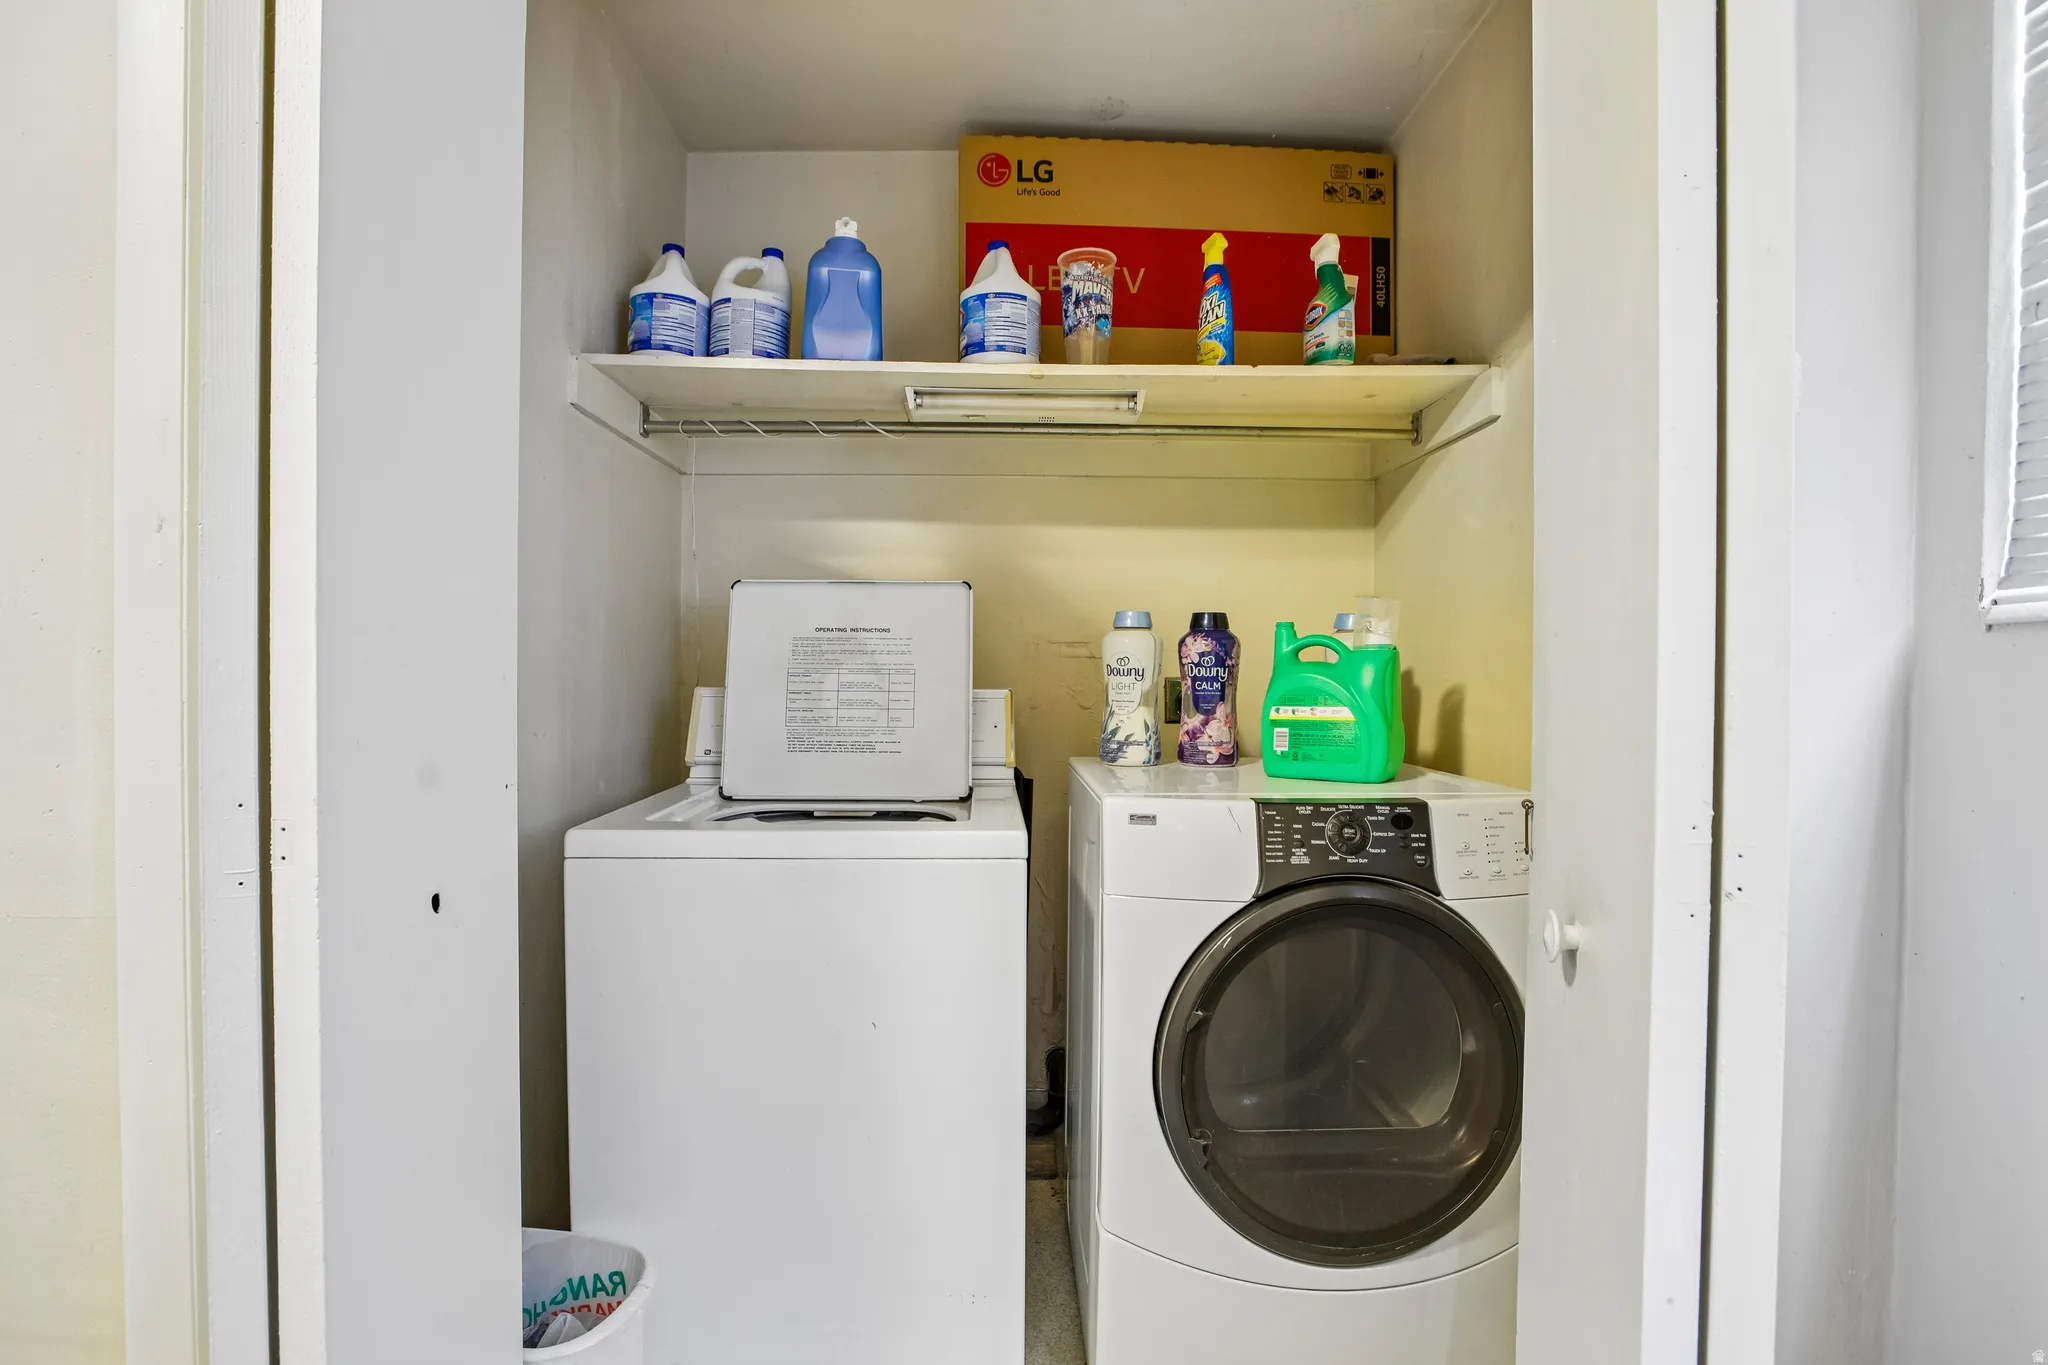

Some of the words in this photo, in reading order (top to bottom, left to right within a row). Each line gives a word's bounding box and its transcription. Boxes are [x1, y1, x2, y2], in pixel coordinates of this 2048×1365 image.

[1016, 159, 1054, 183] LG
[1016, 188, 1037, 196] Life's
[1039, 188, 1061, 196] Good
[1375, 265, 1386, 309] 40LH50
[1106, 664, 1145, 682] Downy
[1188, 663, 1229, 682] Downy
[1111, 682, 1137, 691] LIGHT
[1195, 681, 1221, 690] CALM
